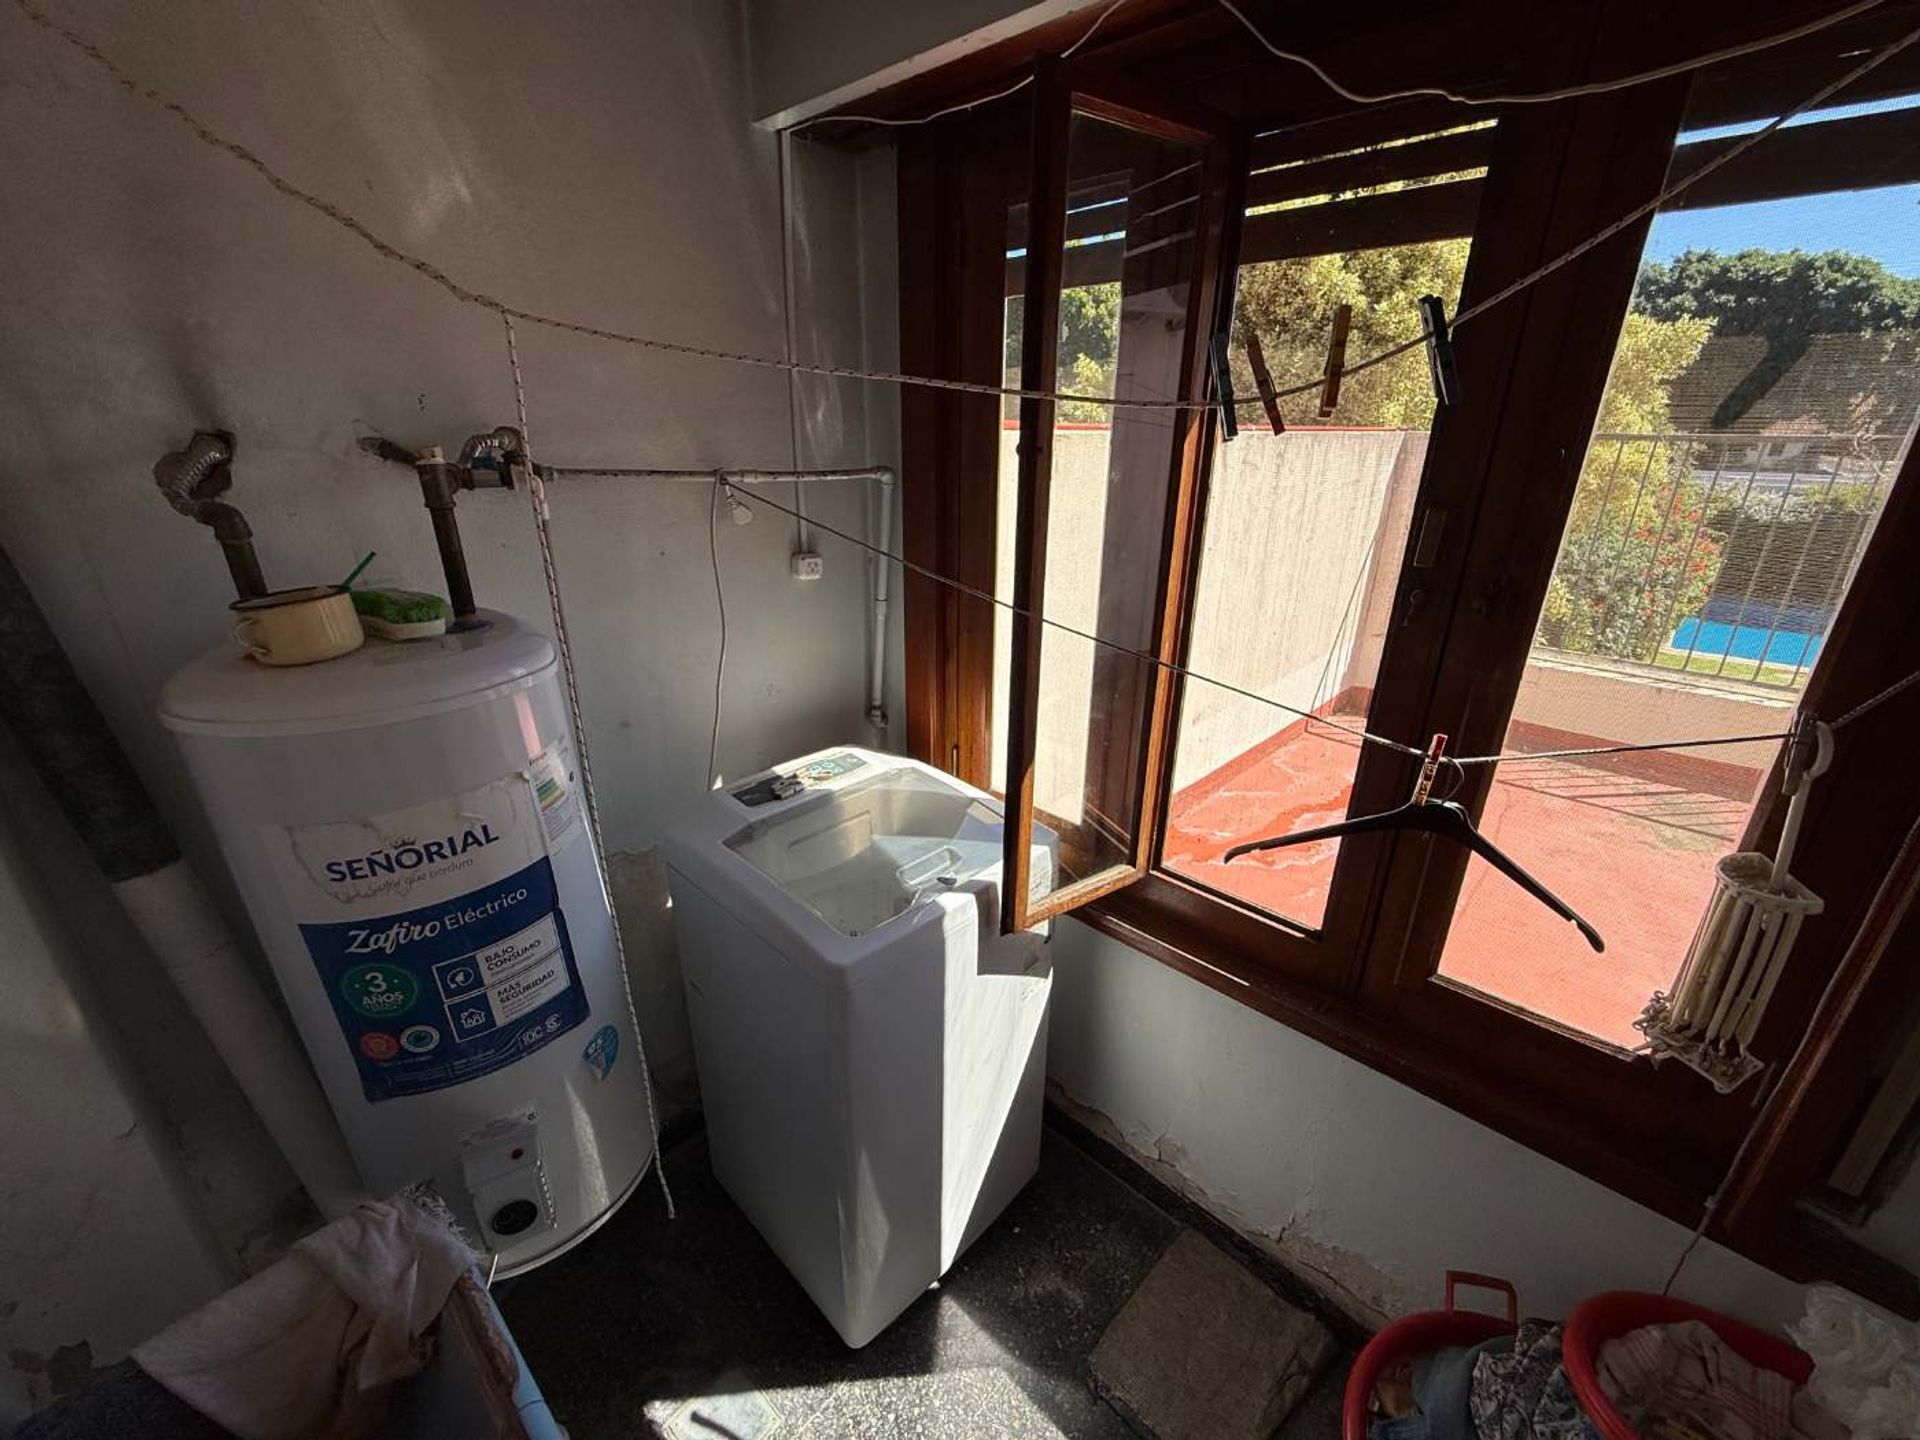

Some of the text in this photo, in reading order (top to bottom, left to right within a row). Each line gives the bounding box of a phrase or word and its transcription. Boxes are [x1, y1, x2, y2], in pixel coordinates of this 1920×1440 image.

[326, 824, 499, 882] SEÑORIAL
[344, 921, 440, 954] Zafiro
[444, 888, 528, 930] Eléctrico
[485, 946, 514, 964] BAJO
[487, 940, 541, 972] CONSUMO
[364, 972, 388, 992] 3
[500, 970, 554, 1003] SEGURIDAD
